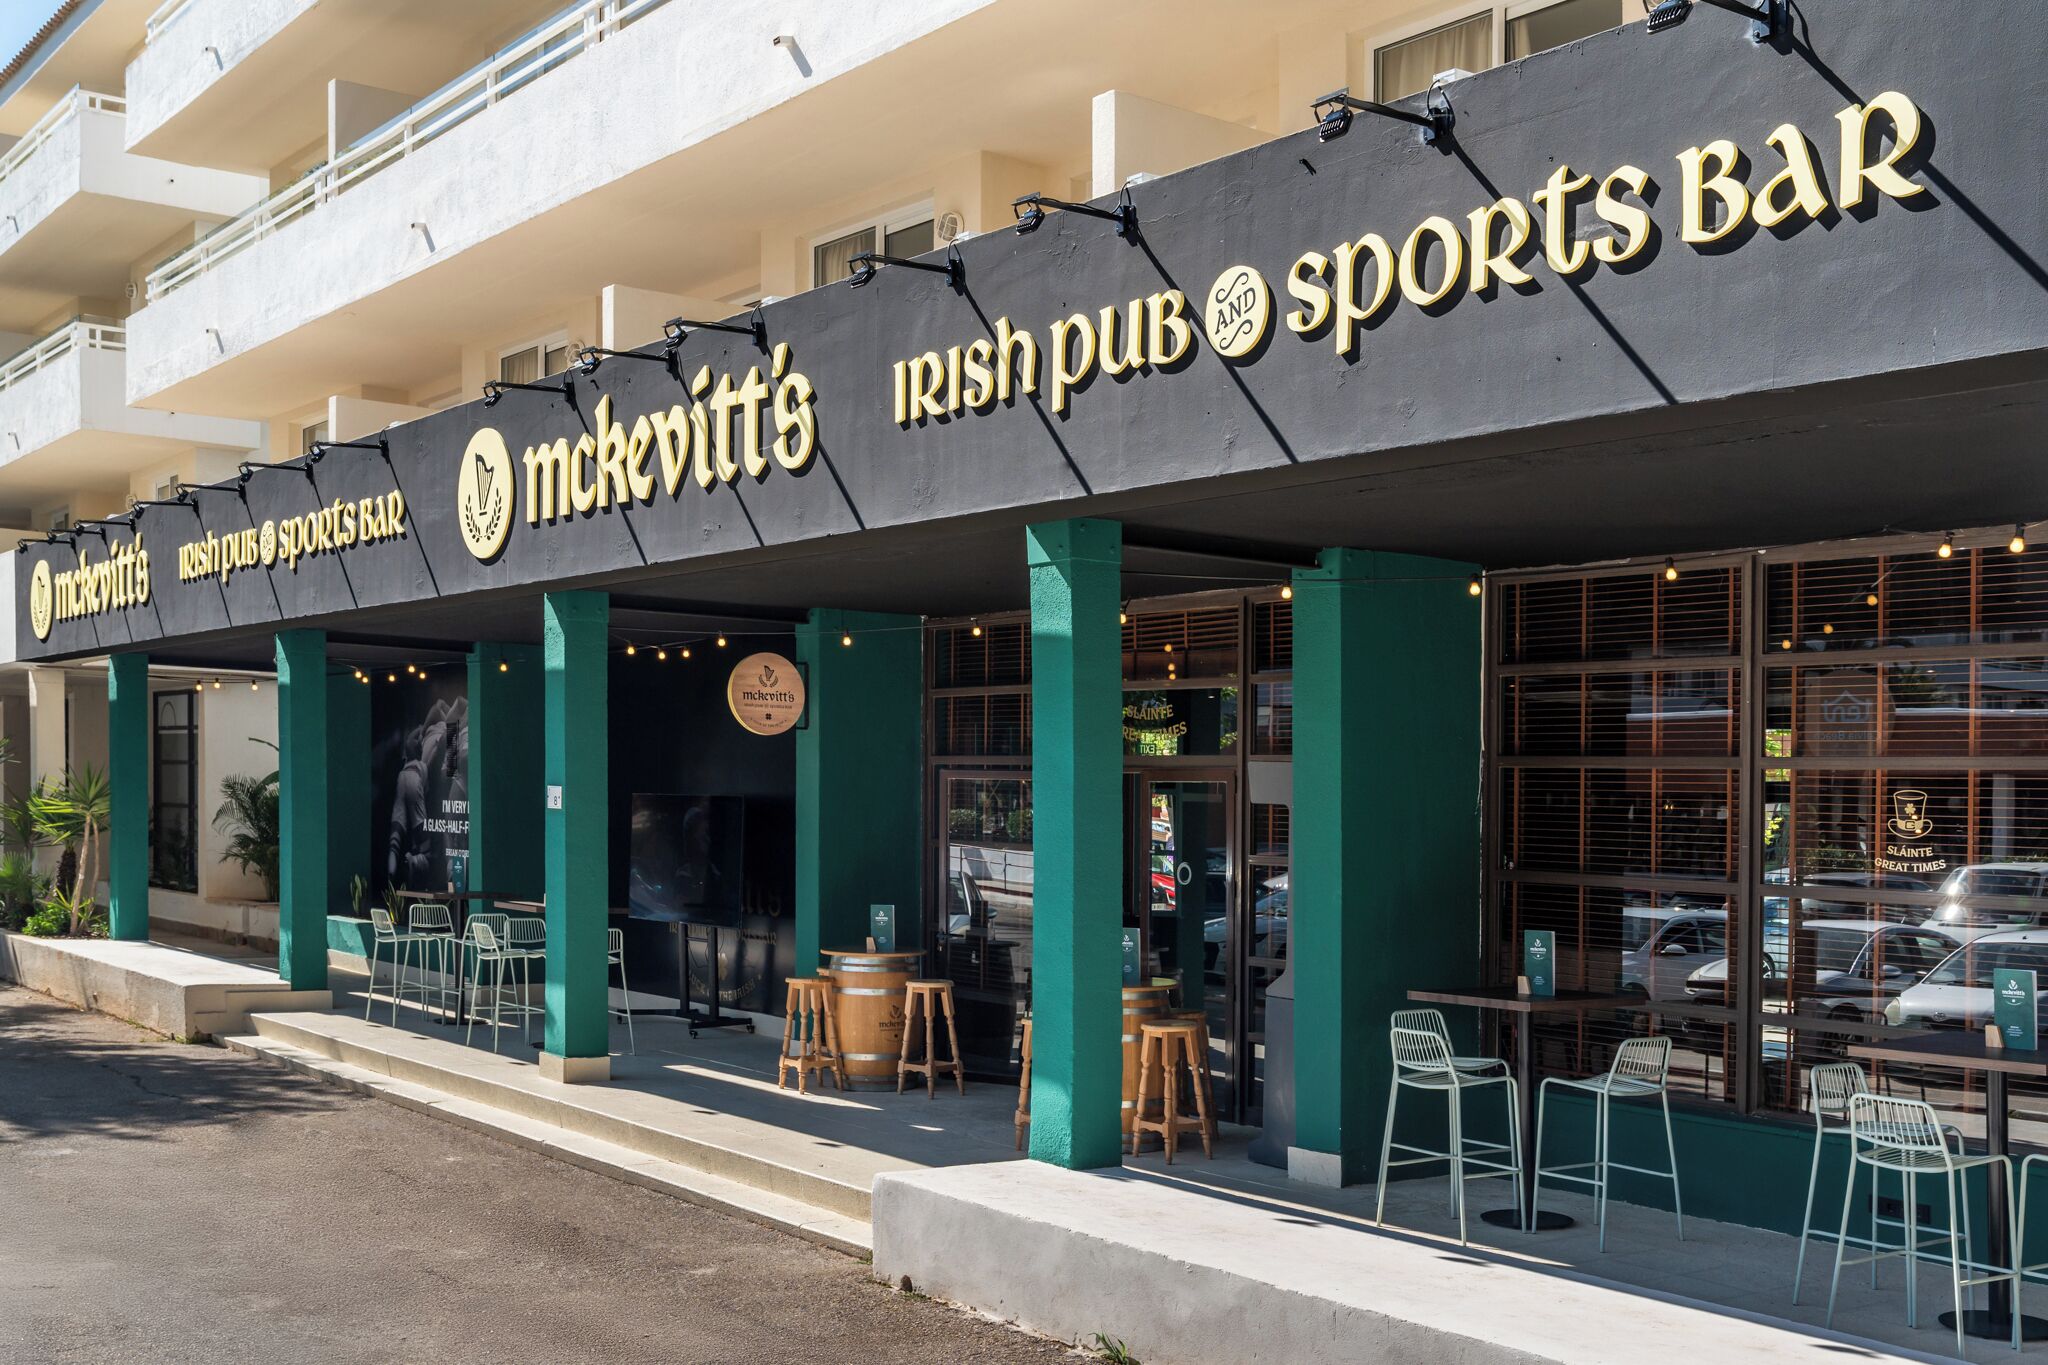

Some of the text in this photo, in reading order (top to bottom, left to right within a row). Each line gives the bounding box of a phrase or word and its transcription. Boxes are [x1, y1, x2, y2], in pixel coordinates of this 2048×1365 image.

[1214, 287, 1256, 336] AND
[742, 690, 795, 702] mckevitt's
[451, 800, 466, 814] VERY
[423, 818, 469, 834] A GLASS-HALF-F
[1887, 845, 1933, 857] SLÁINTE
[1874, 857, 1946, 873] GREAT TIMES
